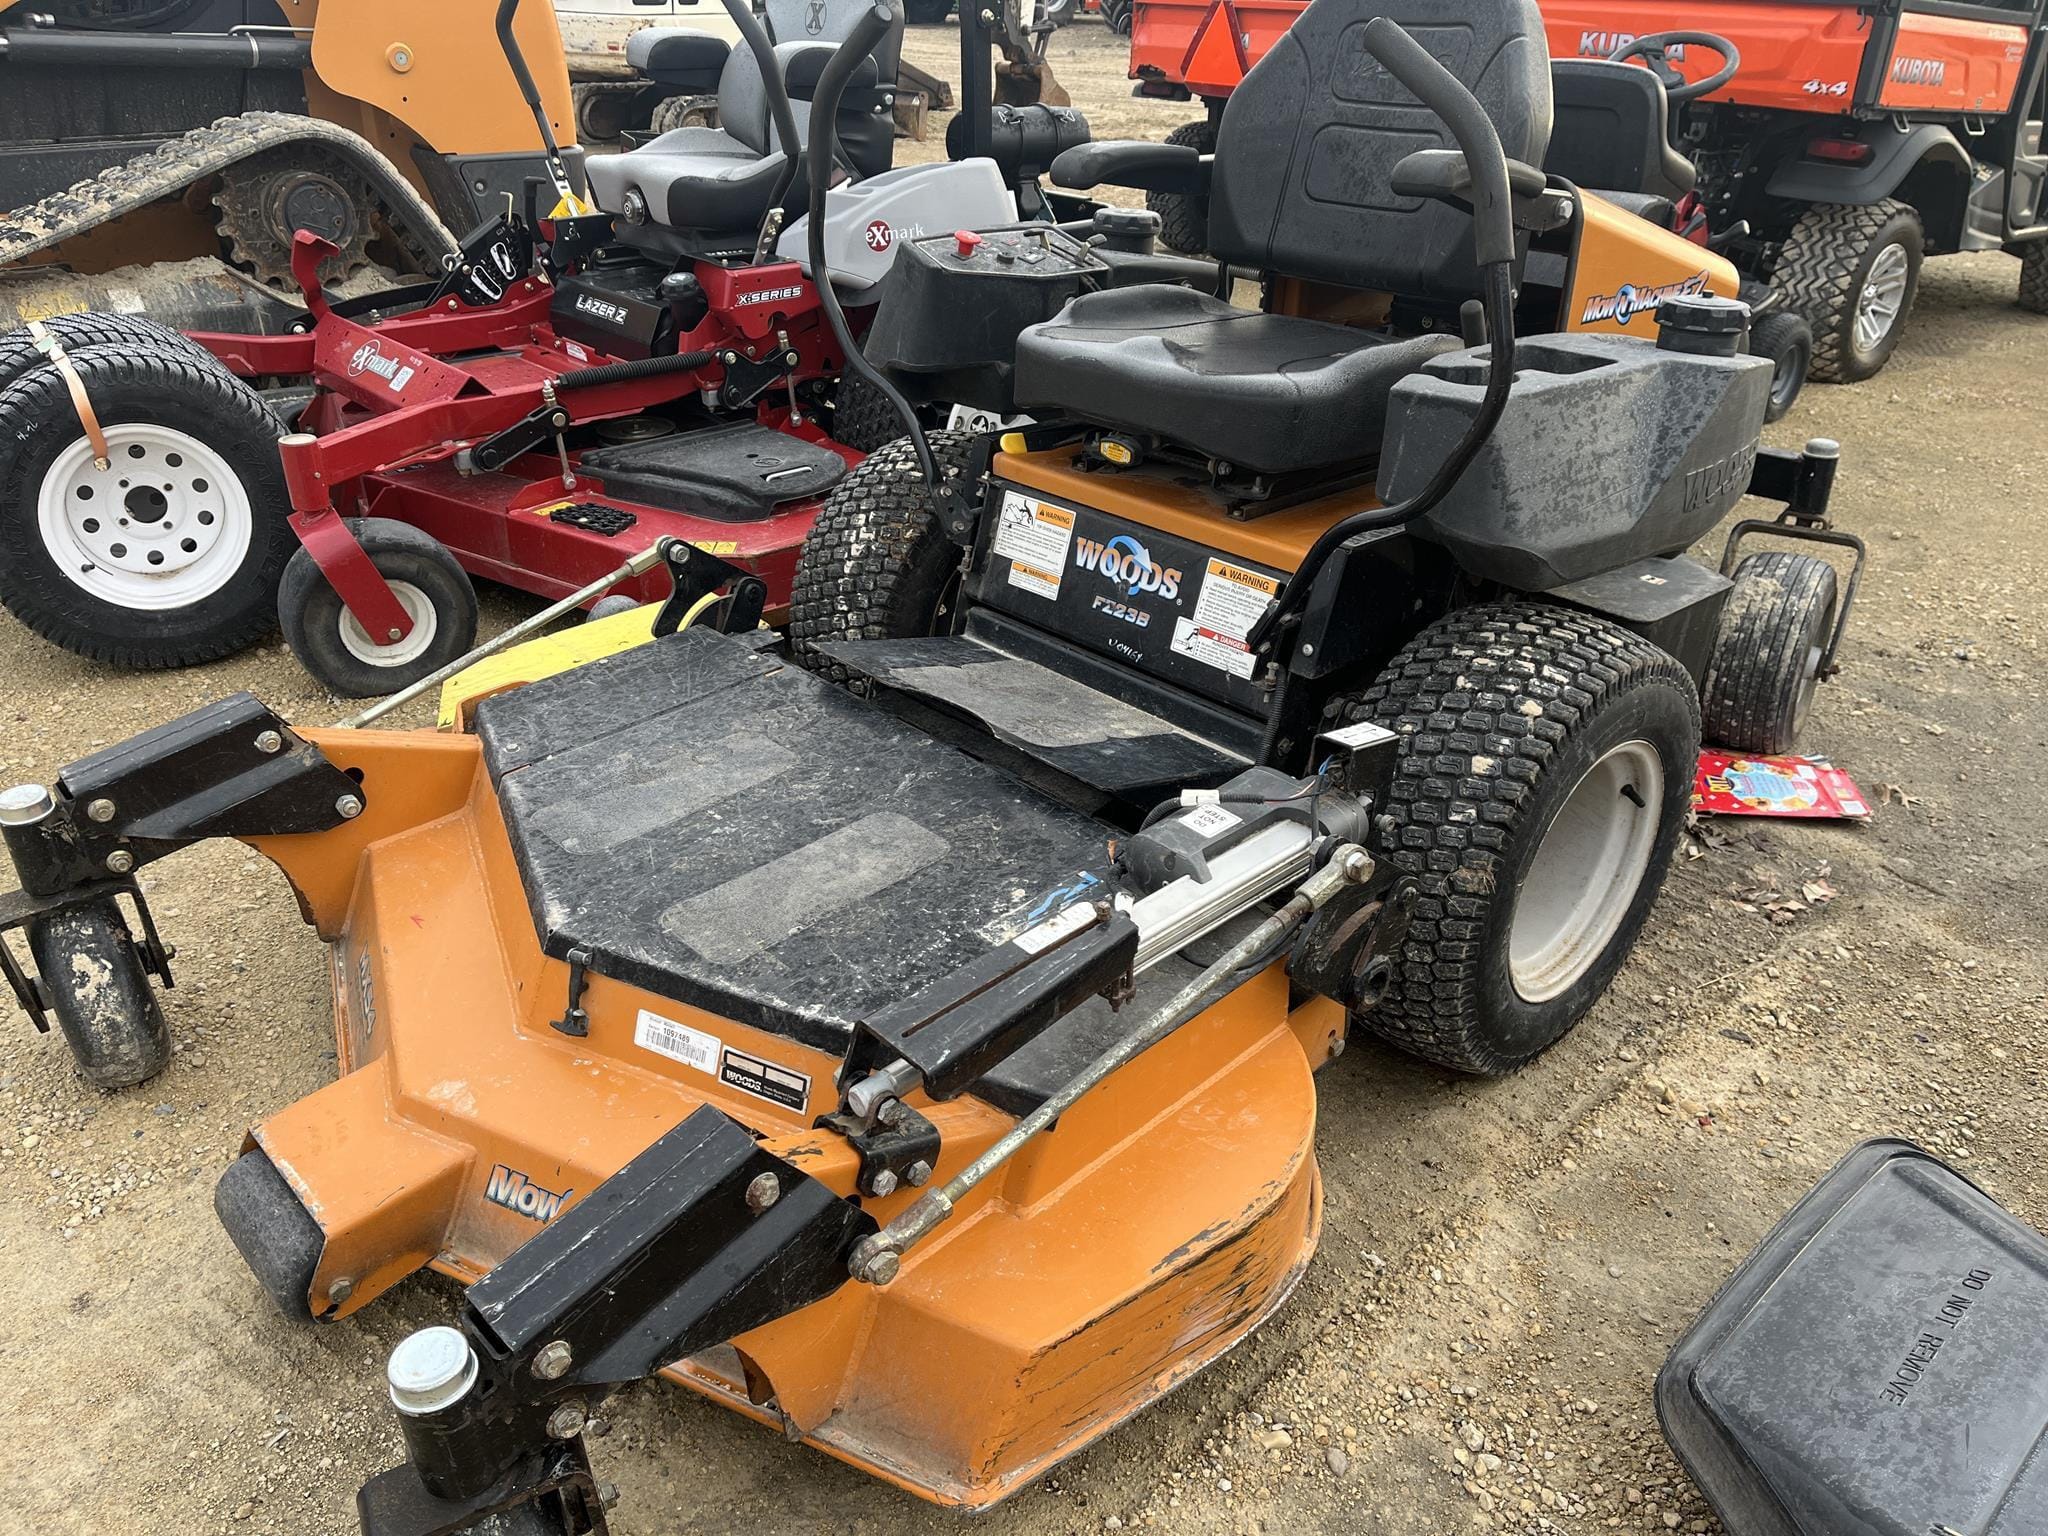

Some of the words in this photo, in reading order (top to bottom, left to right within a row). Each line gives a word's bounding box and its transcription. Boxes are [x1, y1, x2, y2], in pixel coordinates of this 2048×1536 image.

[1578, 31, 1686, 62] KUBA
[1890, 57, 1945, 87] KUBOTA
[1803, 79, 1849, 97] 4x4
[735, 285, 803, 308] X-SERIES
[576, 294, 615, 320] LAZER
[614, 307, 629, 325] Z
[1045, 511, 1071, 525] WARNING
[1076, 536, 1183, 600] WOODS
[1229, 569, 1270, 592] WARNING
[1219, 635, 1246, 651] DANGER
[1705, 774, 1733, 793] RITZ
[726, 1069, 762, 1091] WOODS
[1961, 1268, 1994, 1291] DO
[1935, 1294, 1974, 1330] NOT
[1879, 1332, 1945, 1407] REMOVE
